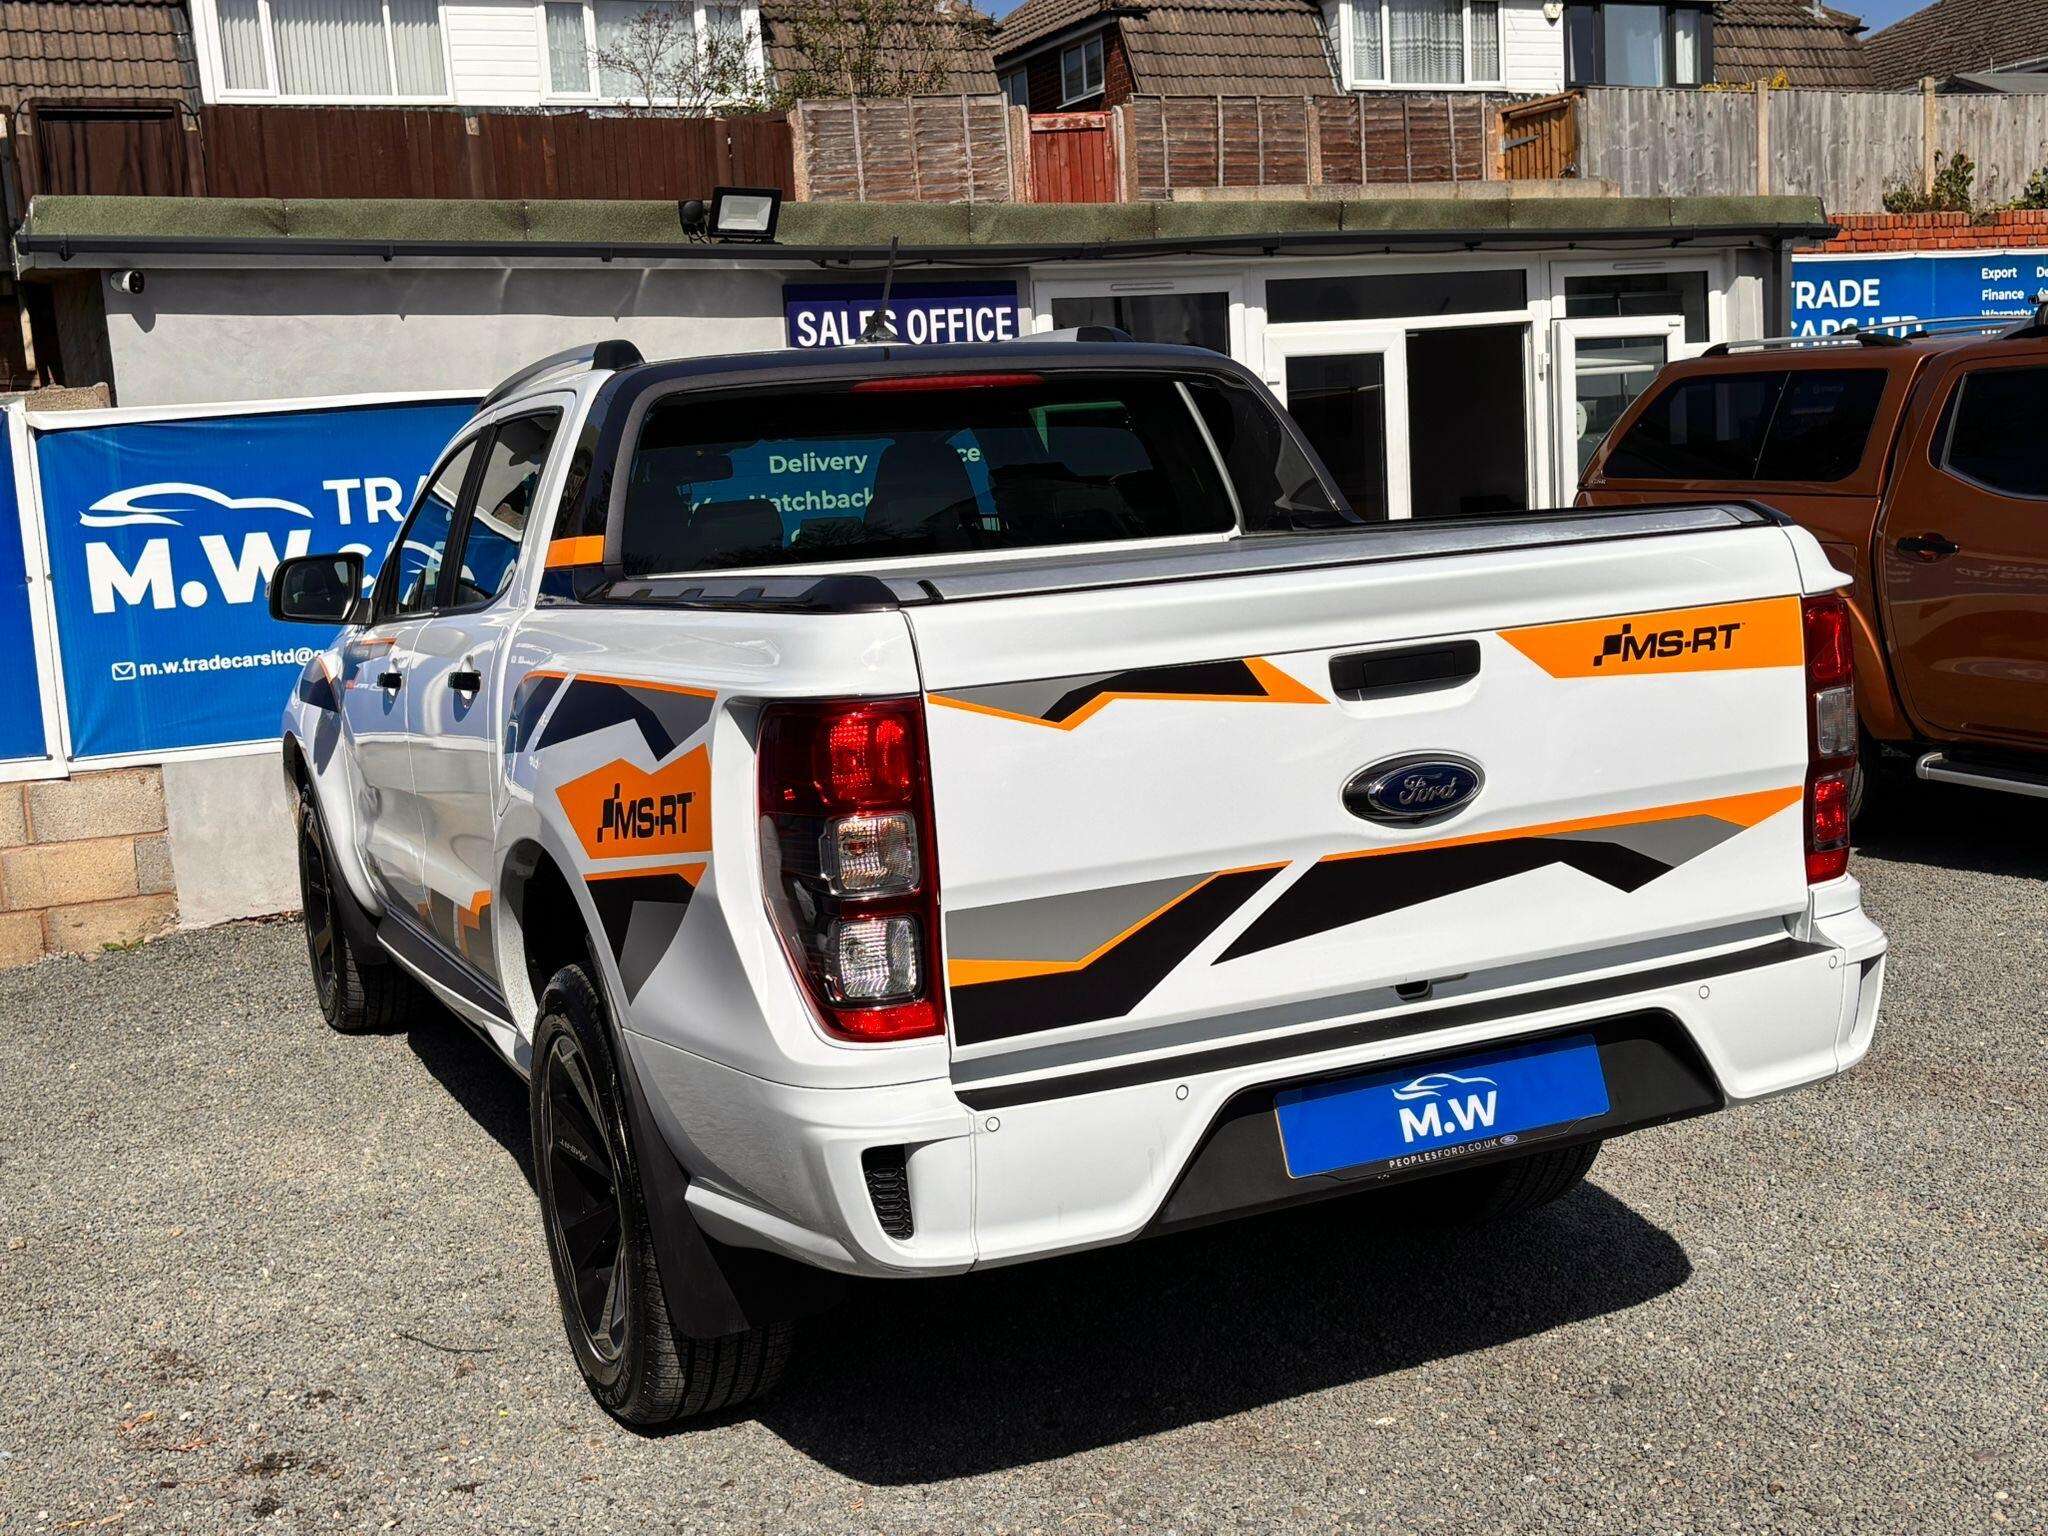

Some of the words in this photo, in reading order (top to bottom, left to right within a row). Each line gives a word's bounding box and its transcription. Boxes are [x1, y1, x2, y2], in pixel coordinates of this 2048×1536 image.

[1981, 267, 2018, 281] Export
[1790, 278, 1880, 310] RADE
[1981, 288, 2025, 301] Finance
[906, 306, 1013, 345] OFFICE
[769, 452, 868, 474] Delivery
[322, 475, 424, 525] TR
[749, 487, 874, 512] atchback
[85, 528, 312, 614] M.W
[1399, 773, 1458, 805] Ford
[1398, 1090, 1498, 1143] M.W
[1388, 1138, 1499, 1169] PEOPLESFORD.CO.UK
